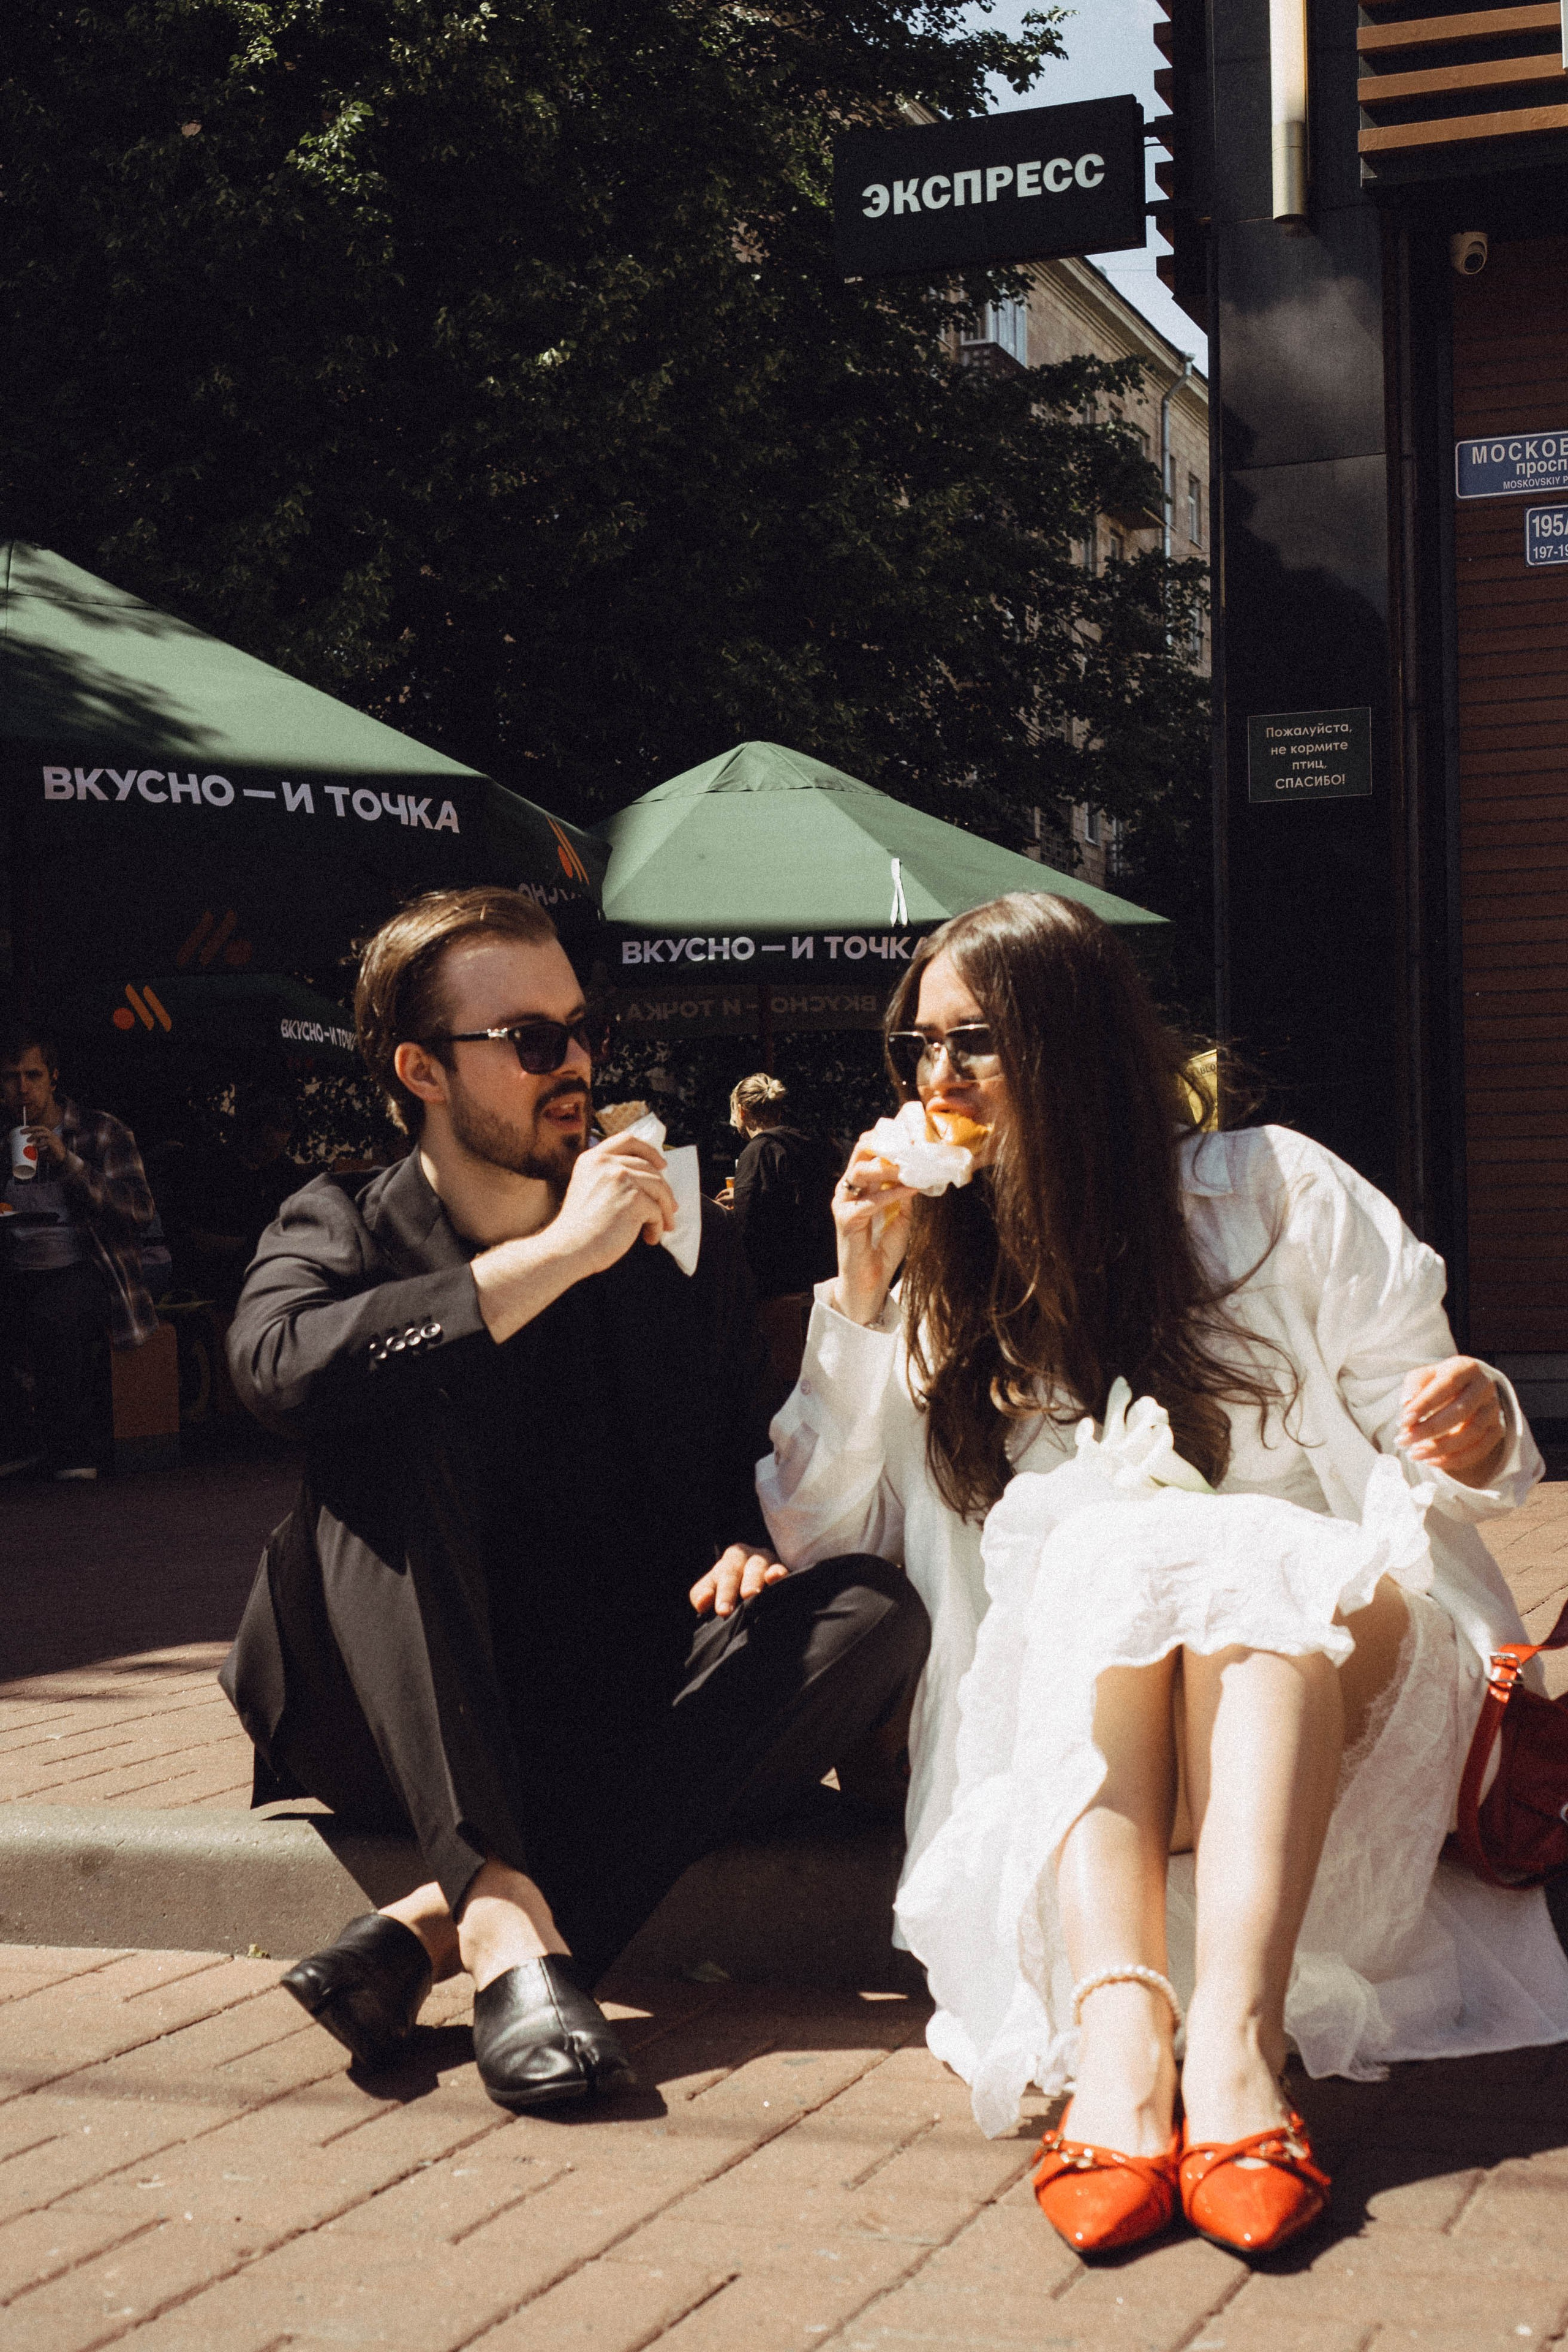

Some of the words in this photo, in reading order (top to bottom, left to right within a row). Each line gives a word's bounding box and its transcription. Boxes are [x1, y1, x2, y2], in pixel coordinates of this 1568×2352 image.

[862, 153, 1105, 218] ЭКСПРЕСС
[1516, 459, 1567, 478] просп
[1503, 476, 1561, 489] MOSKOVSKIY
[1532, 513, 1568, 538] 195
[1265, 723, 1352, 738] Пожалуйста,
[1271, 745, 1286, 755] не
[1291, 741, 1348, 755] кормите
[1292, 760, 1327, 770] птиц,
[1275, 774, 1345, 790] СПАСИБО!
[42, 766, 235, 807] ВКУСНО
[281, 782, 315, 814] И
[323, 785, 460, 833] ТОЧКА
[622, 937, 755, 964] ВКУСНО
[791, 936, 813, 959] И
[281, 1018, 324, 1042] ВКУСНО
